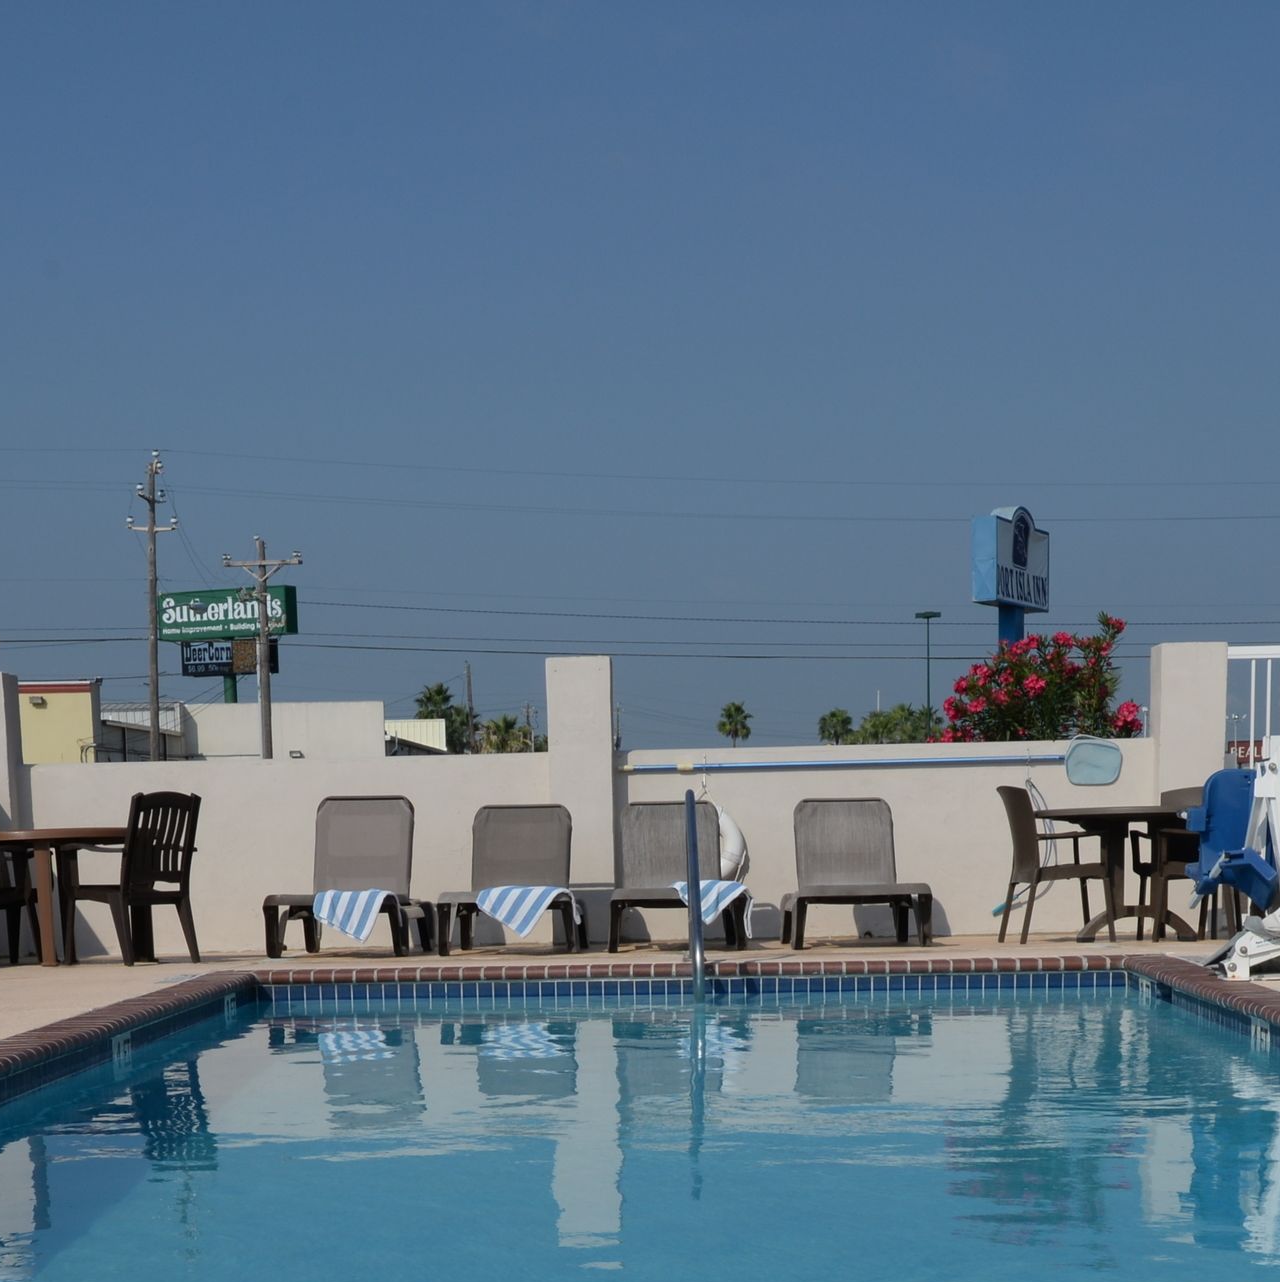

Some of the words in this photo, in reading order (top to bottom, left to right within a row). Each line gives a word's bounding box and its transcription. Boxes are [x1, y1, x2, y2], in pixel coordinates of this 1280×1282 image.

[1015, 569, 1033, 603] ISLA
[1033, 575, 1048, 607] INN
[162, 593, 283, 624] Sutherlans
